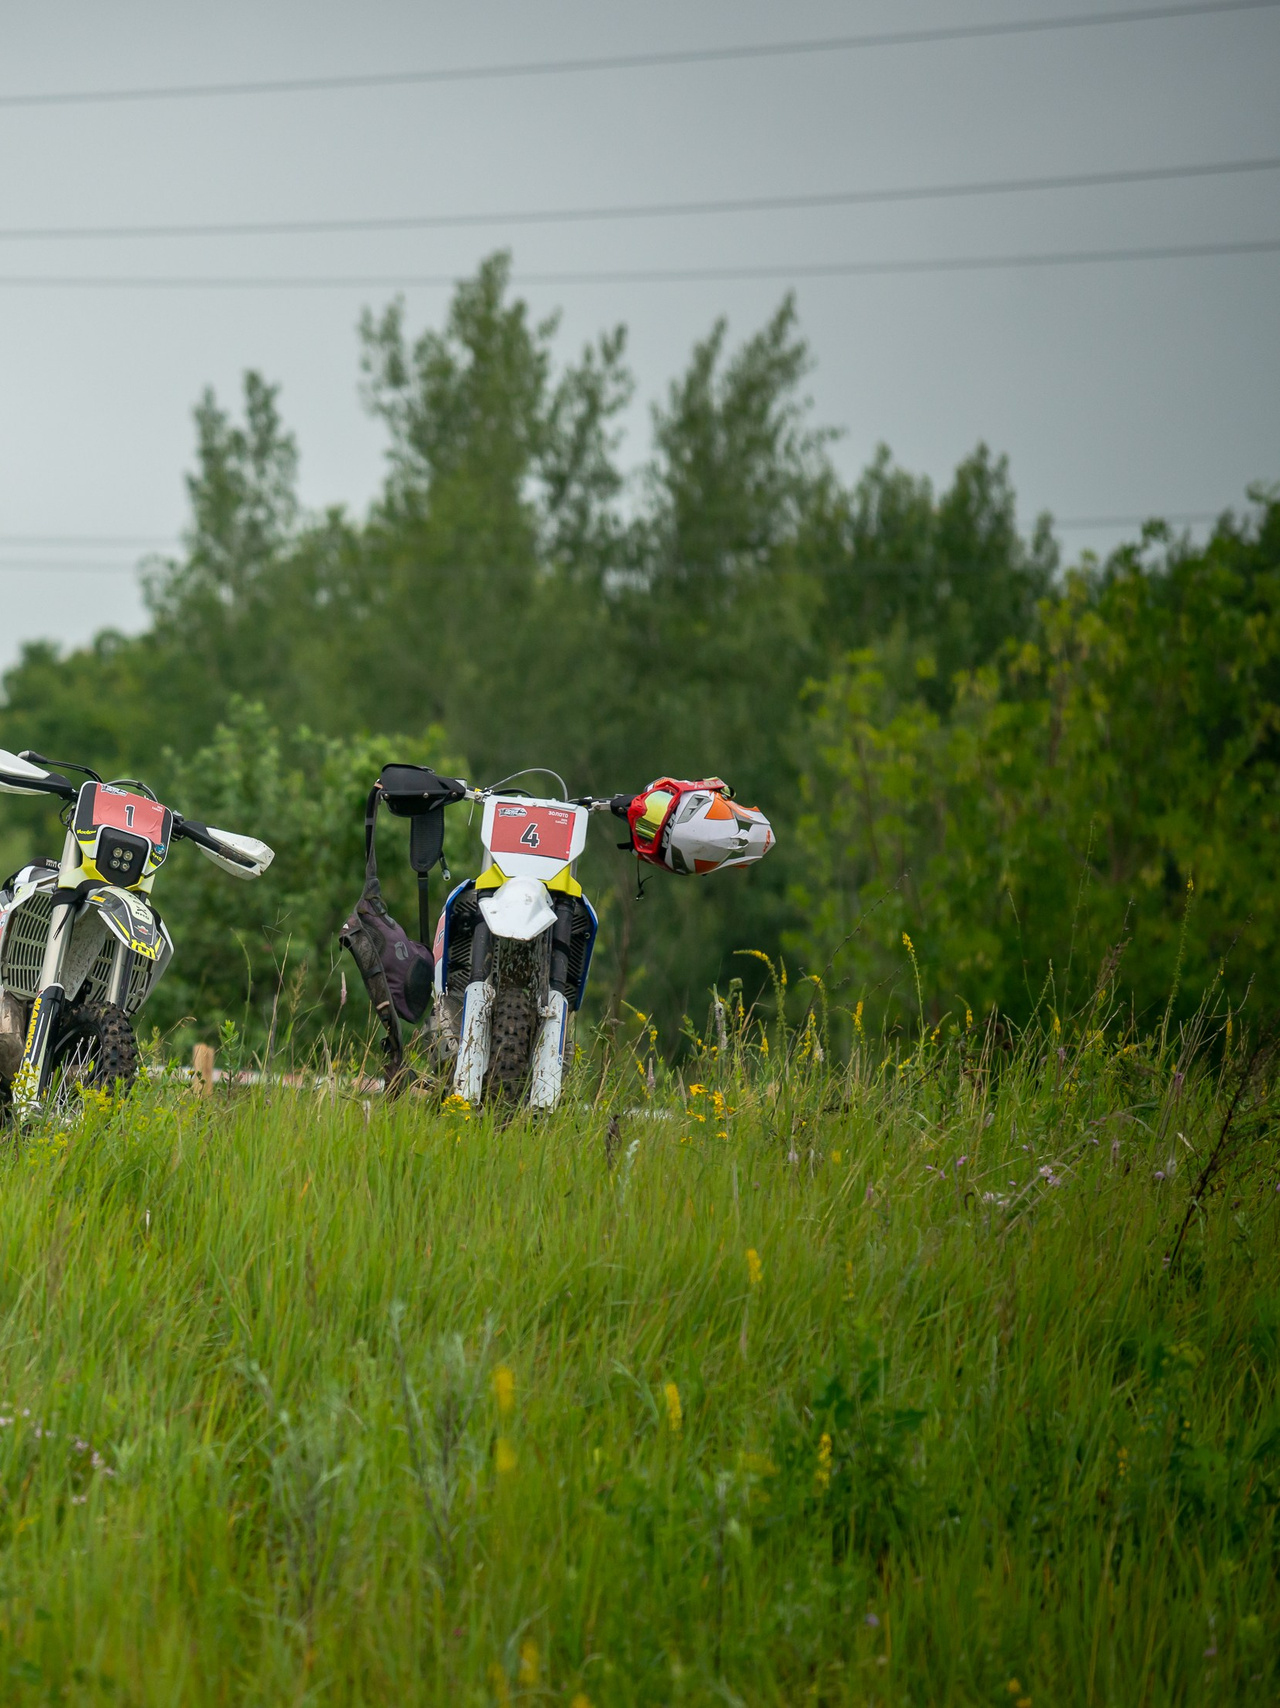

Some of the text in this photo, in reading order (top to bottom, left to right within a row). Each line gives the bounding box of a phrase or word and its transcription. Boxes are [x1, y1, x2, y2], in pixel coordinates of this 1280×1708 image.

[125, 804, 136, 828] 1
[520, 822, 540, 848] 4
[23, 997, 43, 1058] MANNOL
